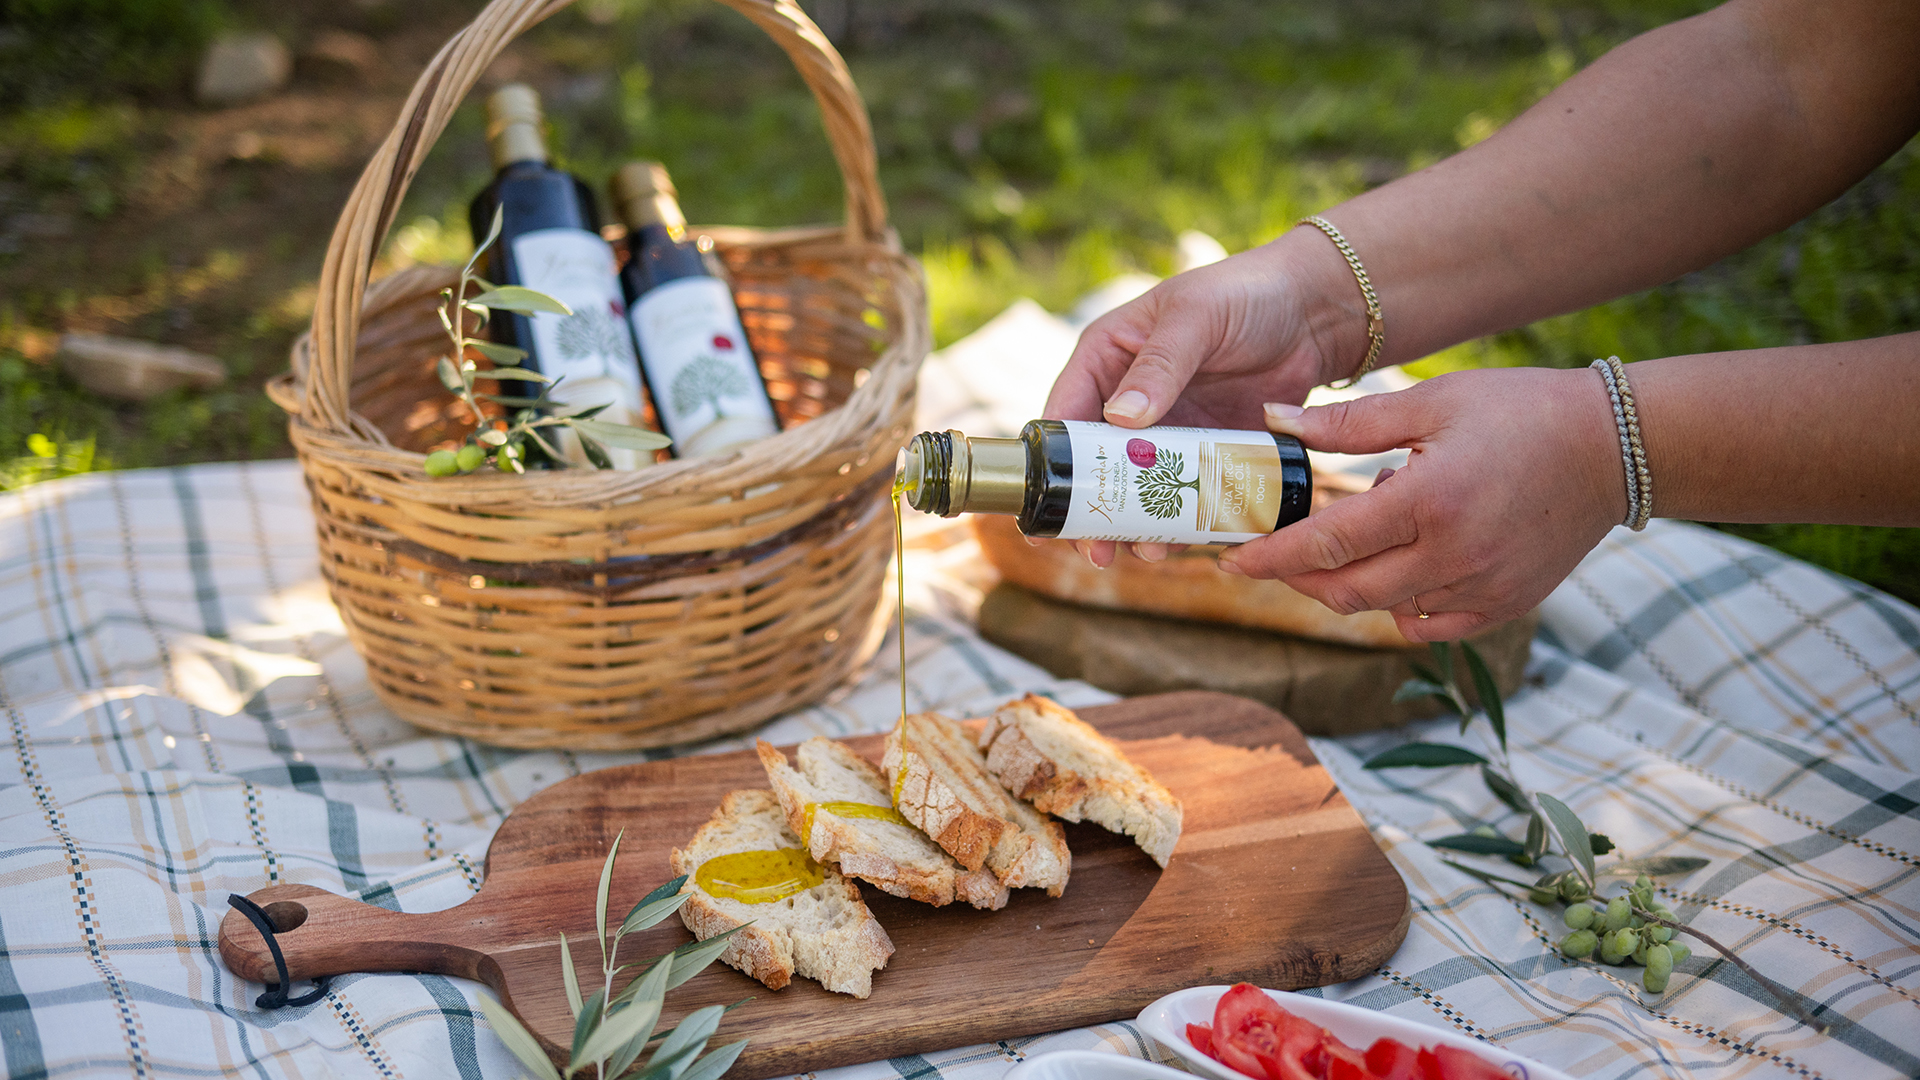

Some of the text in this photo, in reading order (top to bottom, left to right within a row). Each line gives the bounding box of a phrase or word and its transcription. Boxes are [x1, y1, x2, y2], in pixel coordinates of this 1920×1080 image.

[1111, 461, 1121, 504] ΟΙΚΟΓΕΝΕΙΑ
[1117, 453, 1128, 513] ΠΑΝΤΑΖΟΠΟΥΛΟΥ
[1219, 452, 1234, 523] EXTRA VIRGIN
[1231, 462, 1245, 515] OLIVE OIL
[1256, 474, 1265, 504] 100ml
